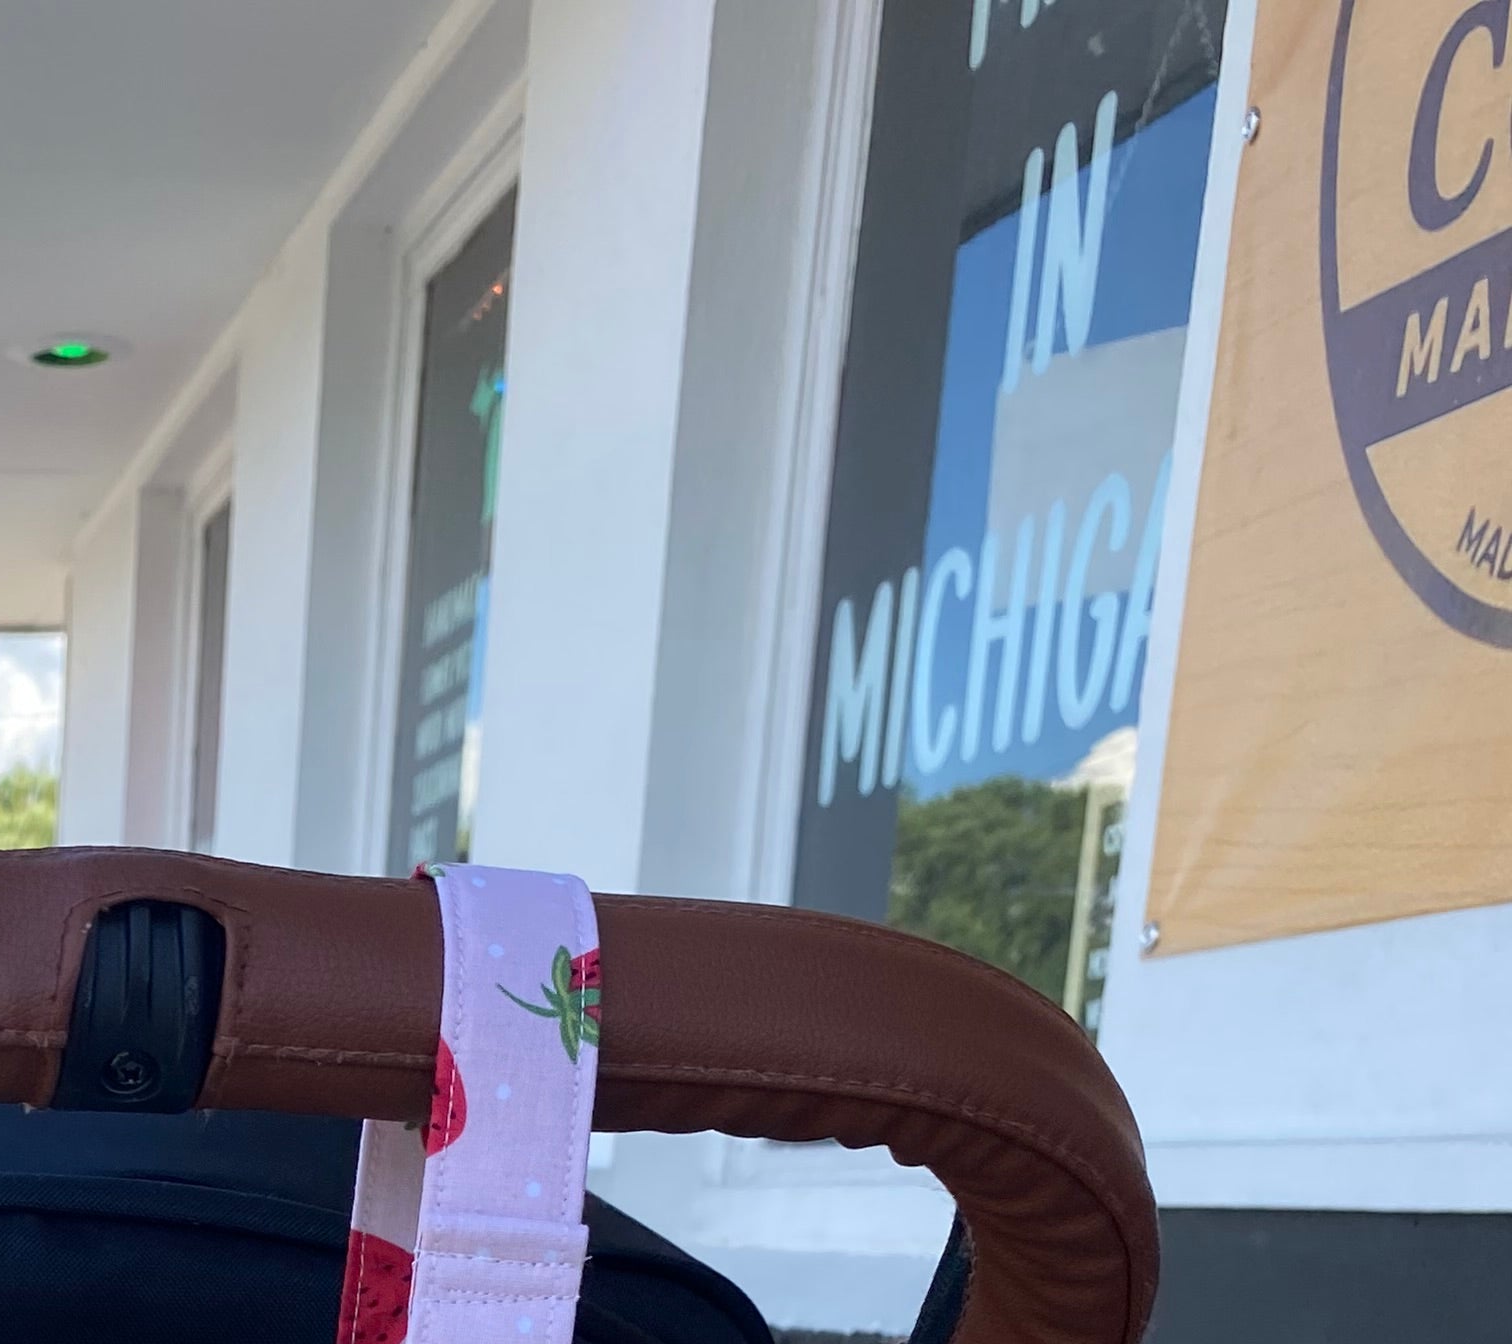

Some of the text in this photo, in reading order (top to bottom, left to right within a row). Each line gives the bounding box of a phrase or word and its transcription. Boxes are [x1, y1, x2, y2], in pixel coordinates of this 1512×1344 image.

[1408, 0, 1512, 232] C
[1000, 90, 1118, 395] IN
[1396, 277, 1512, 398] MA
